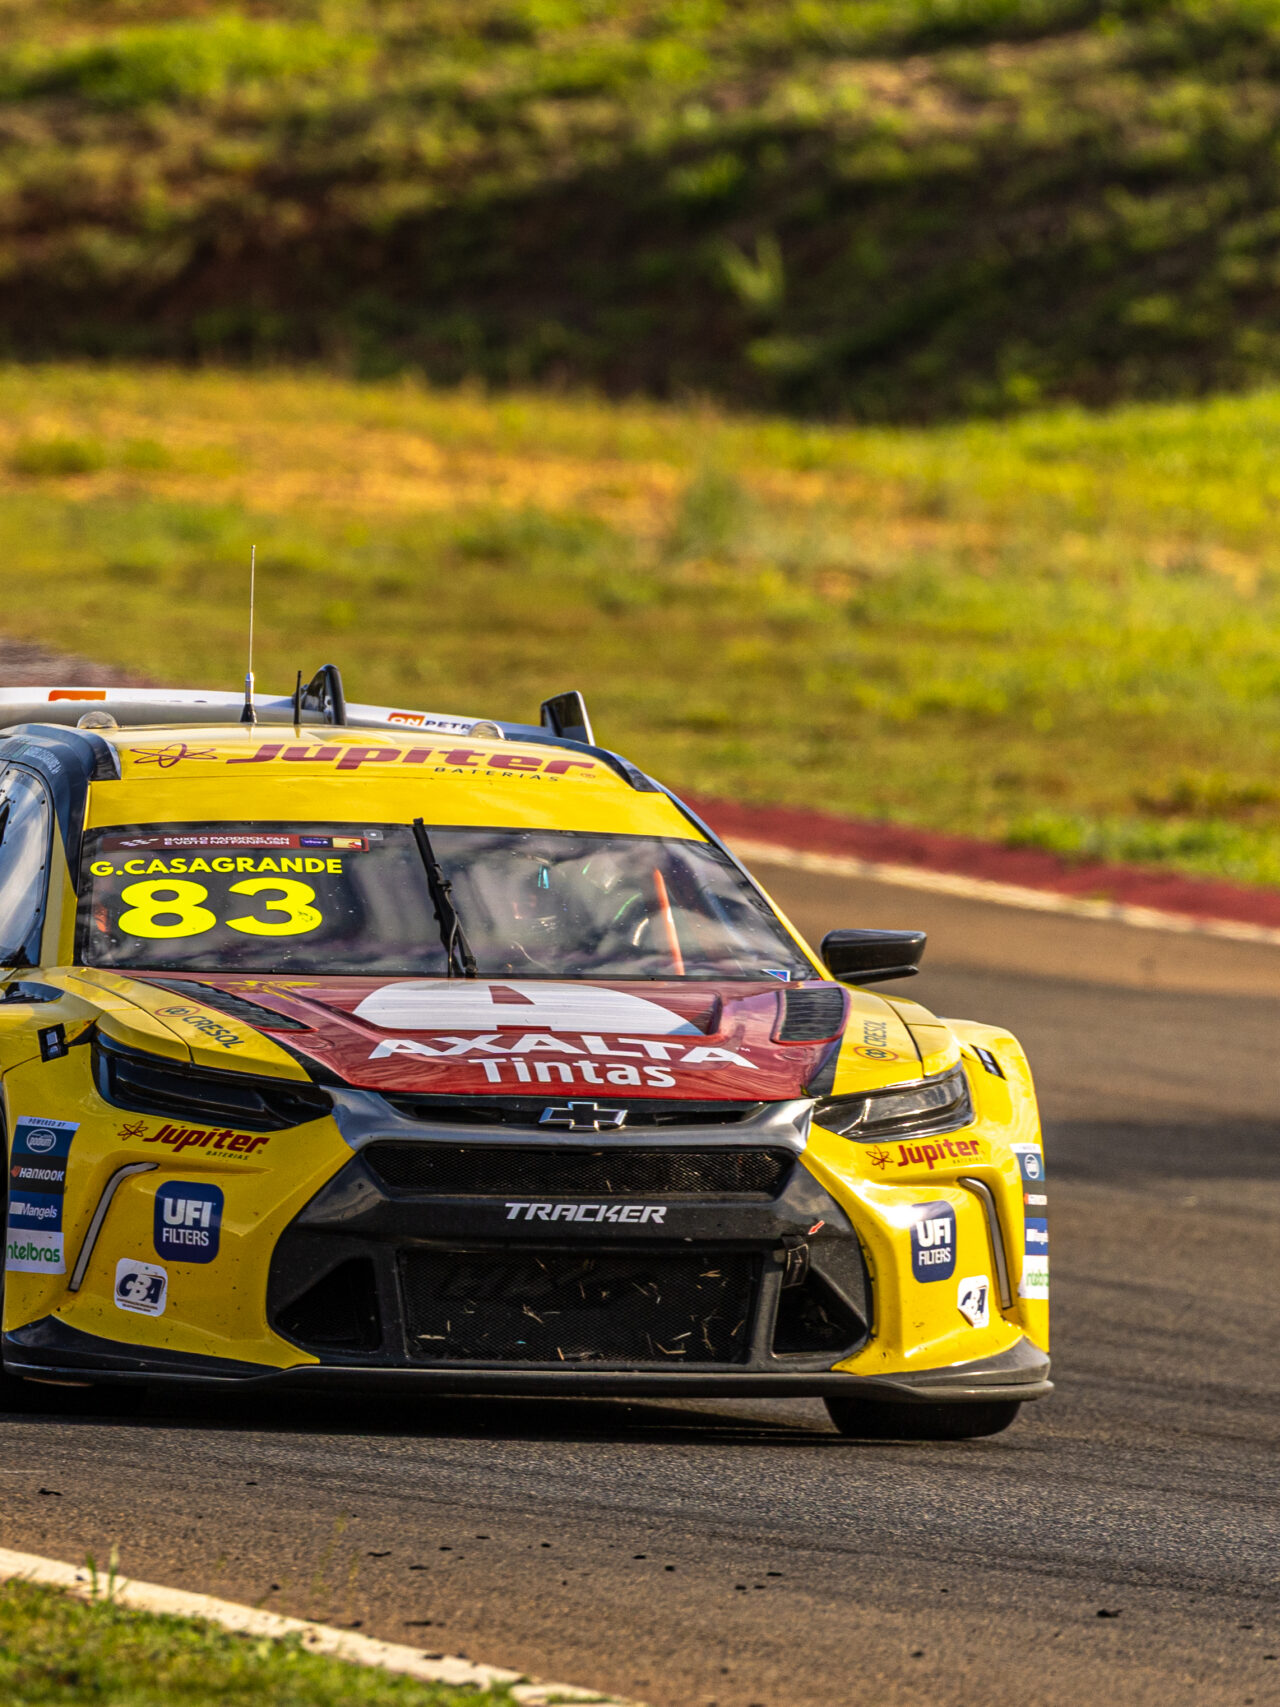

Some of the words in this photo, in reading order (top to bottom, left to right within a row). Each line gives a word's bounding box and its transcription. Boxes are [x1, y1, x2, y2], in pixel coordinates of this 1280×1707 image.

[424, 720, 471, 731] PETR
[434, 766, 559, 782] BATERIAS
[90, 856, 343, 877] G.CASAGRANDE
[118, 877, 322, 939] 83
[181, 1015, 245, 1049] CRESOL
[368, 1033, 760, 1069] AXALTA
[469, 1057, 677, 1088] Tintas
[205, 1150, 249, 1161] BATERIAS
[22, 1205, 58, 1220] Mangels
[163, 1198, 213, 1228] UFI
[505, 1202, 668, 1225] TRACKER
[162, 1228, 210, 1246] FILTERS
[916, 1217, 953, 1247] UFI
[7, 1241, 61, 1263] ntelbras
[919, 1248, 952, 1266] FILTERS
